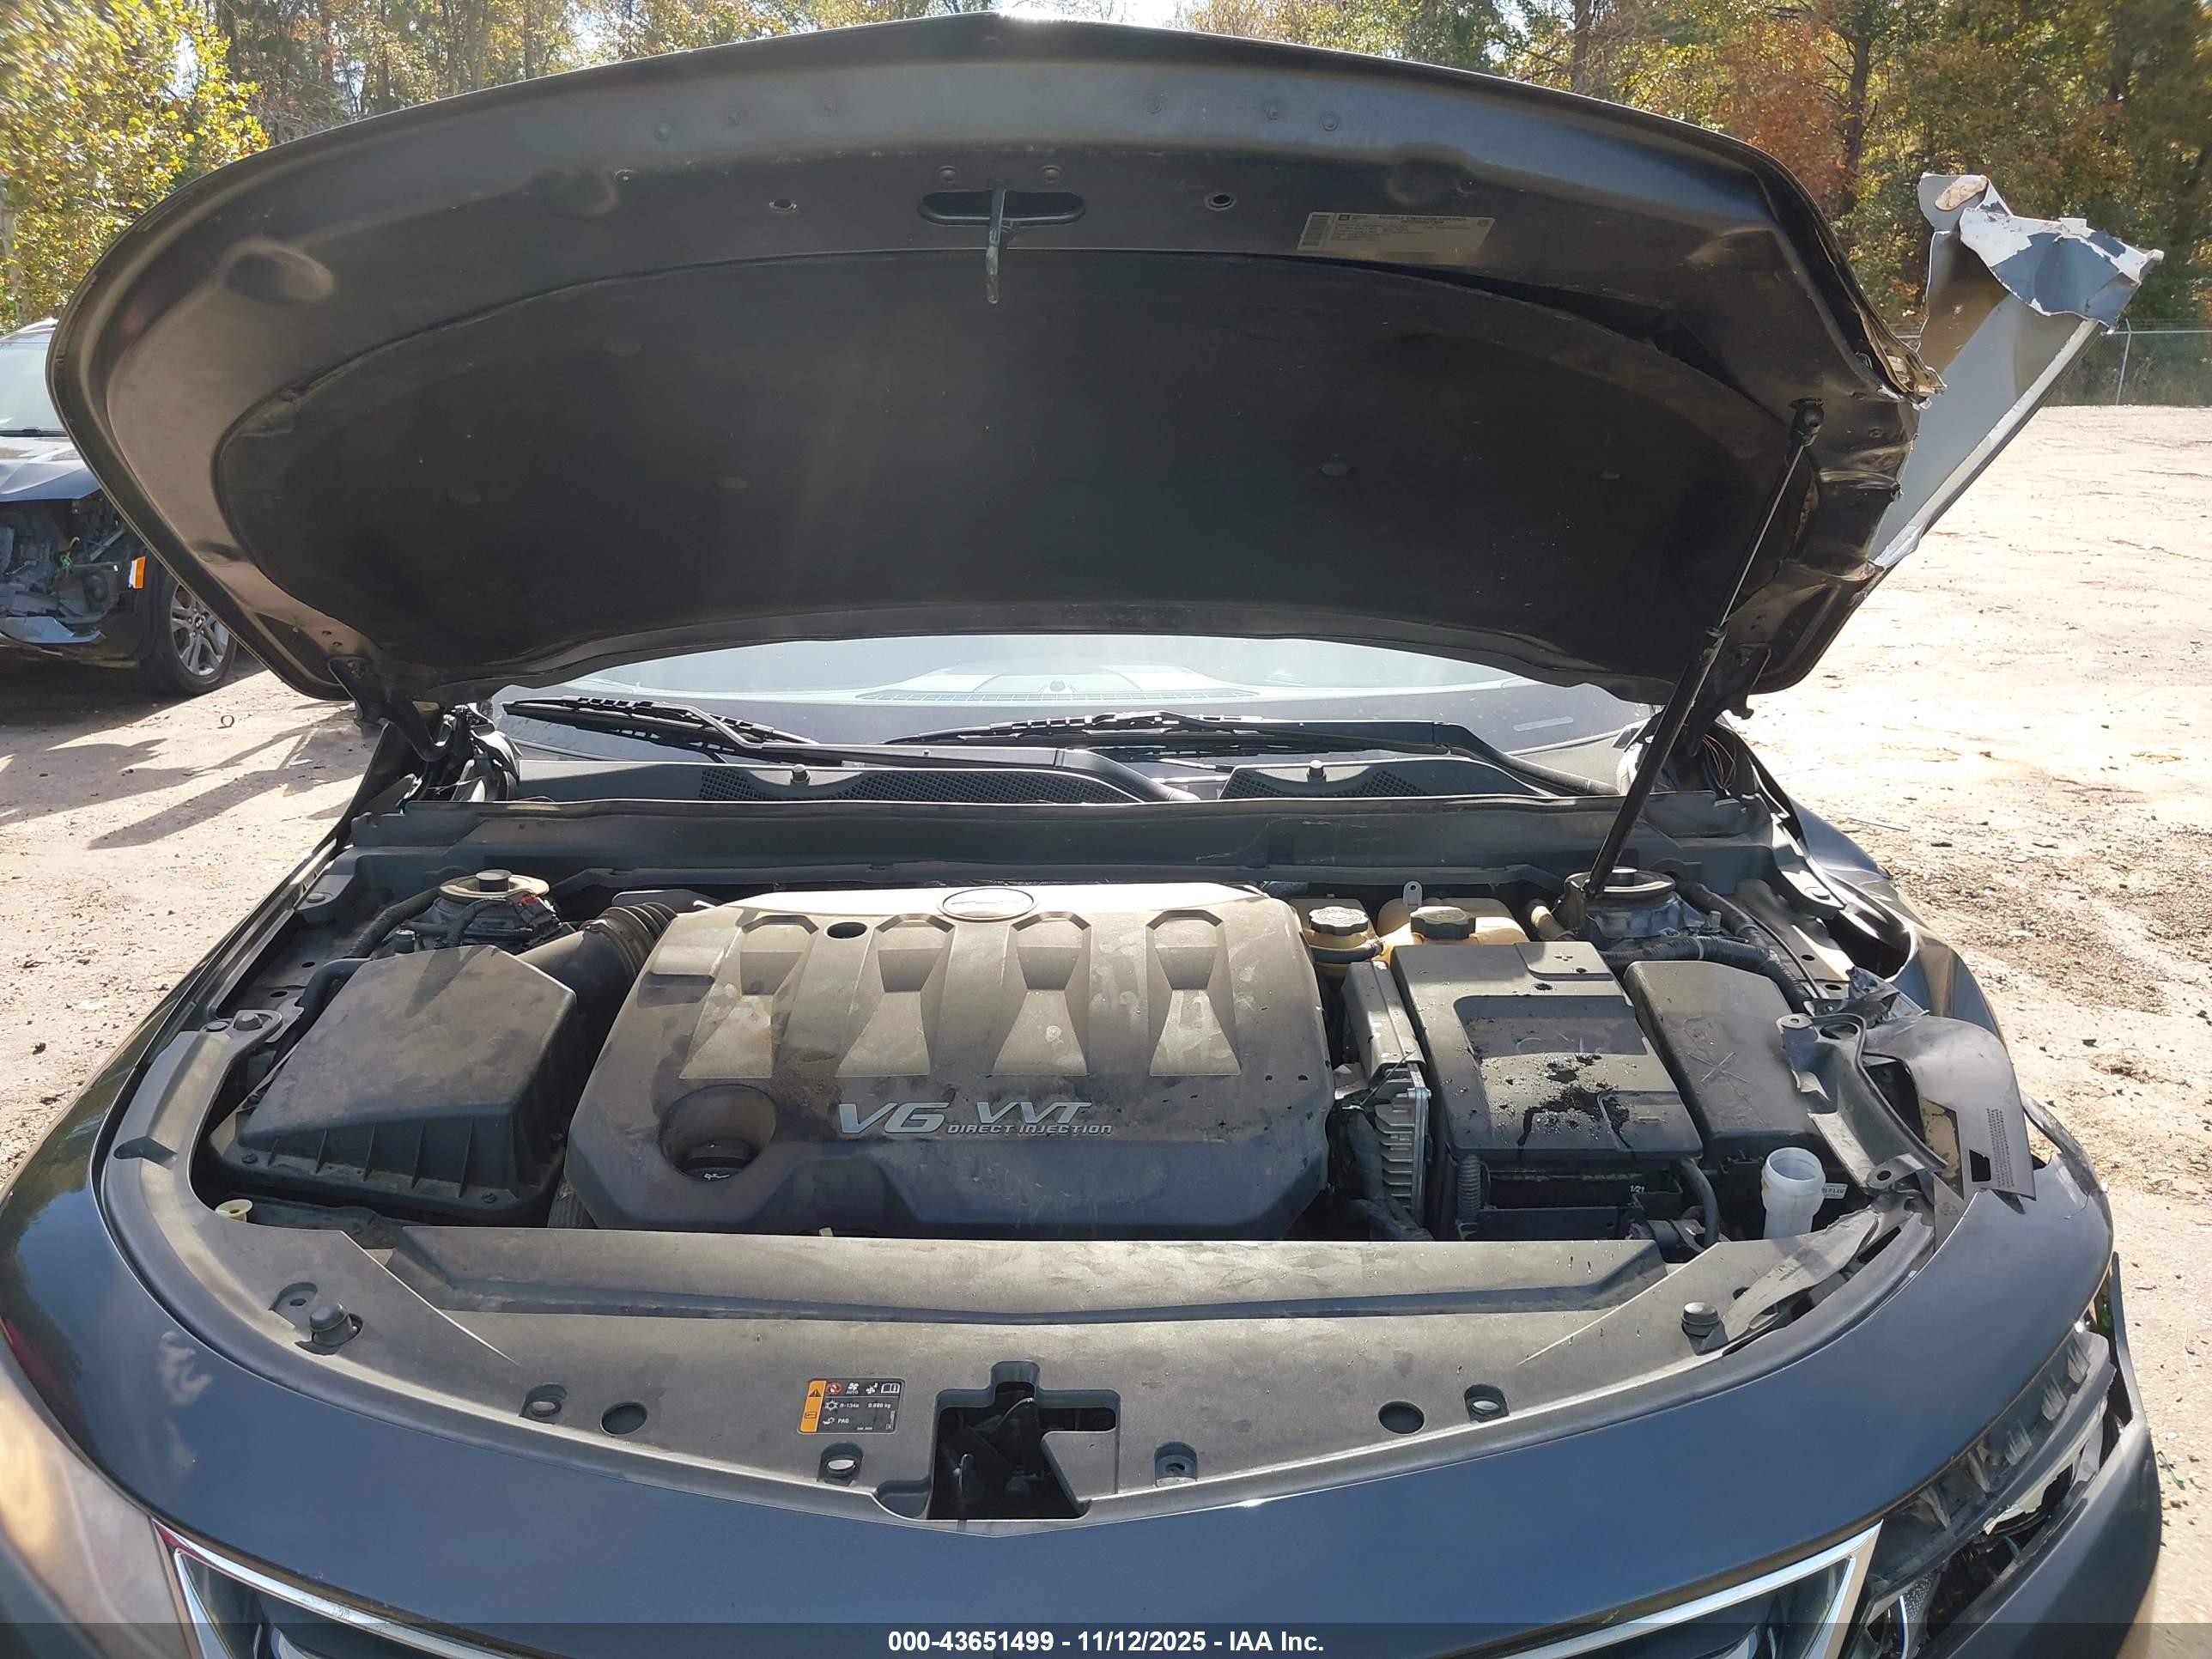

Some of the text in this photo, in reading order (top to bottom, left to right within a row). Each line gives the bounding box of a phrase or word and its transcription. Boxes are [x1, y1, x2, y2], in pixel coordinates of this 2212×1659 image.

[838, 1102, 1092, 1133] V6 VVT
[947, 1124, 1114, 1134] DIRECT INJECTION
